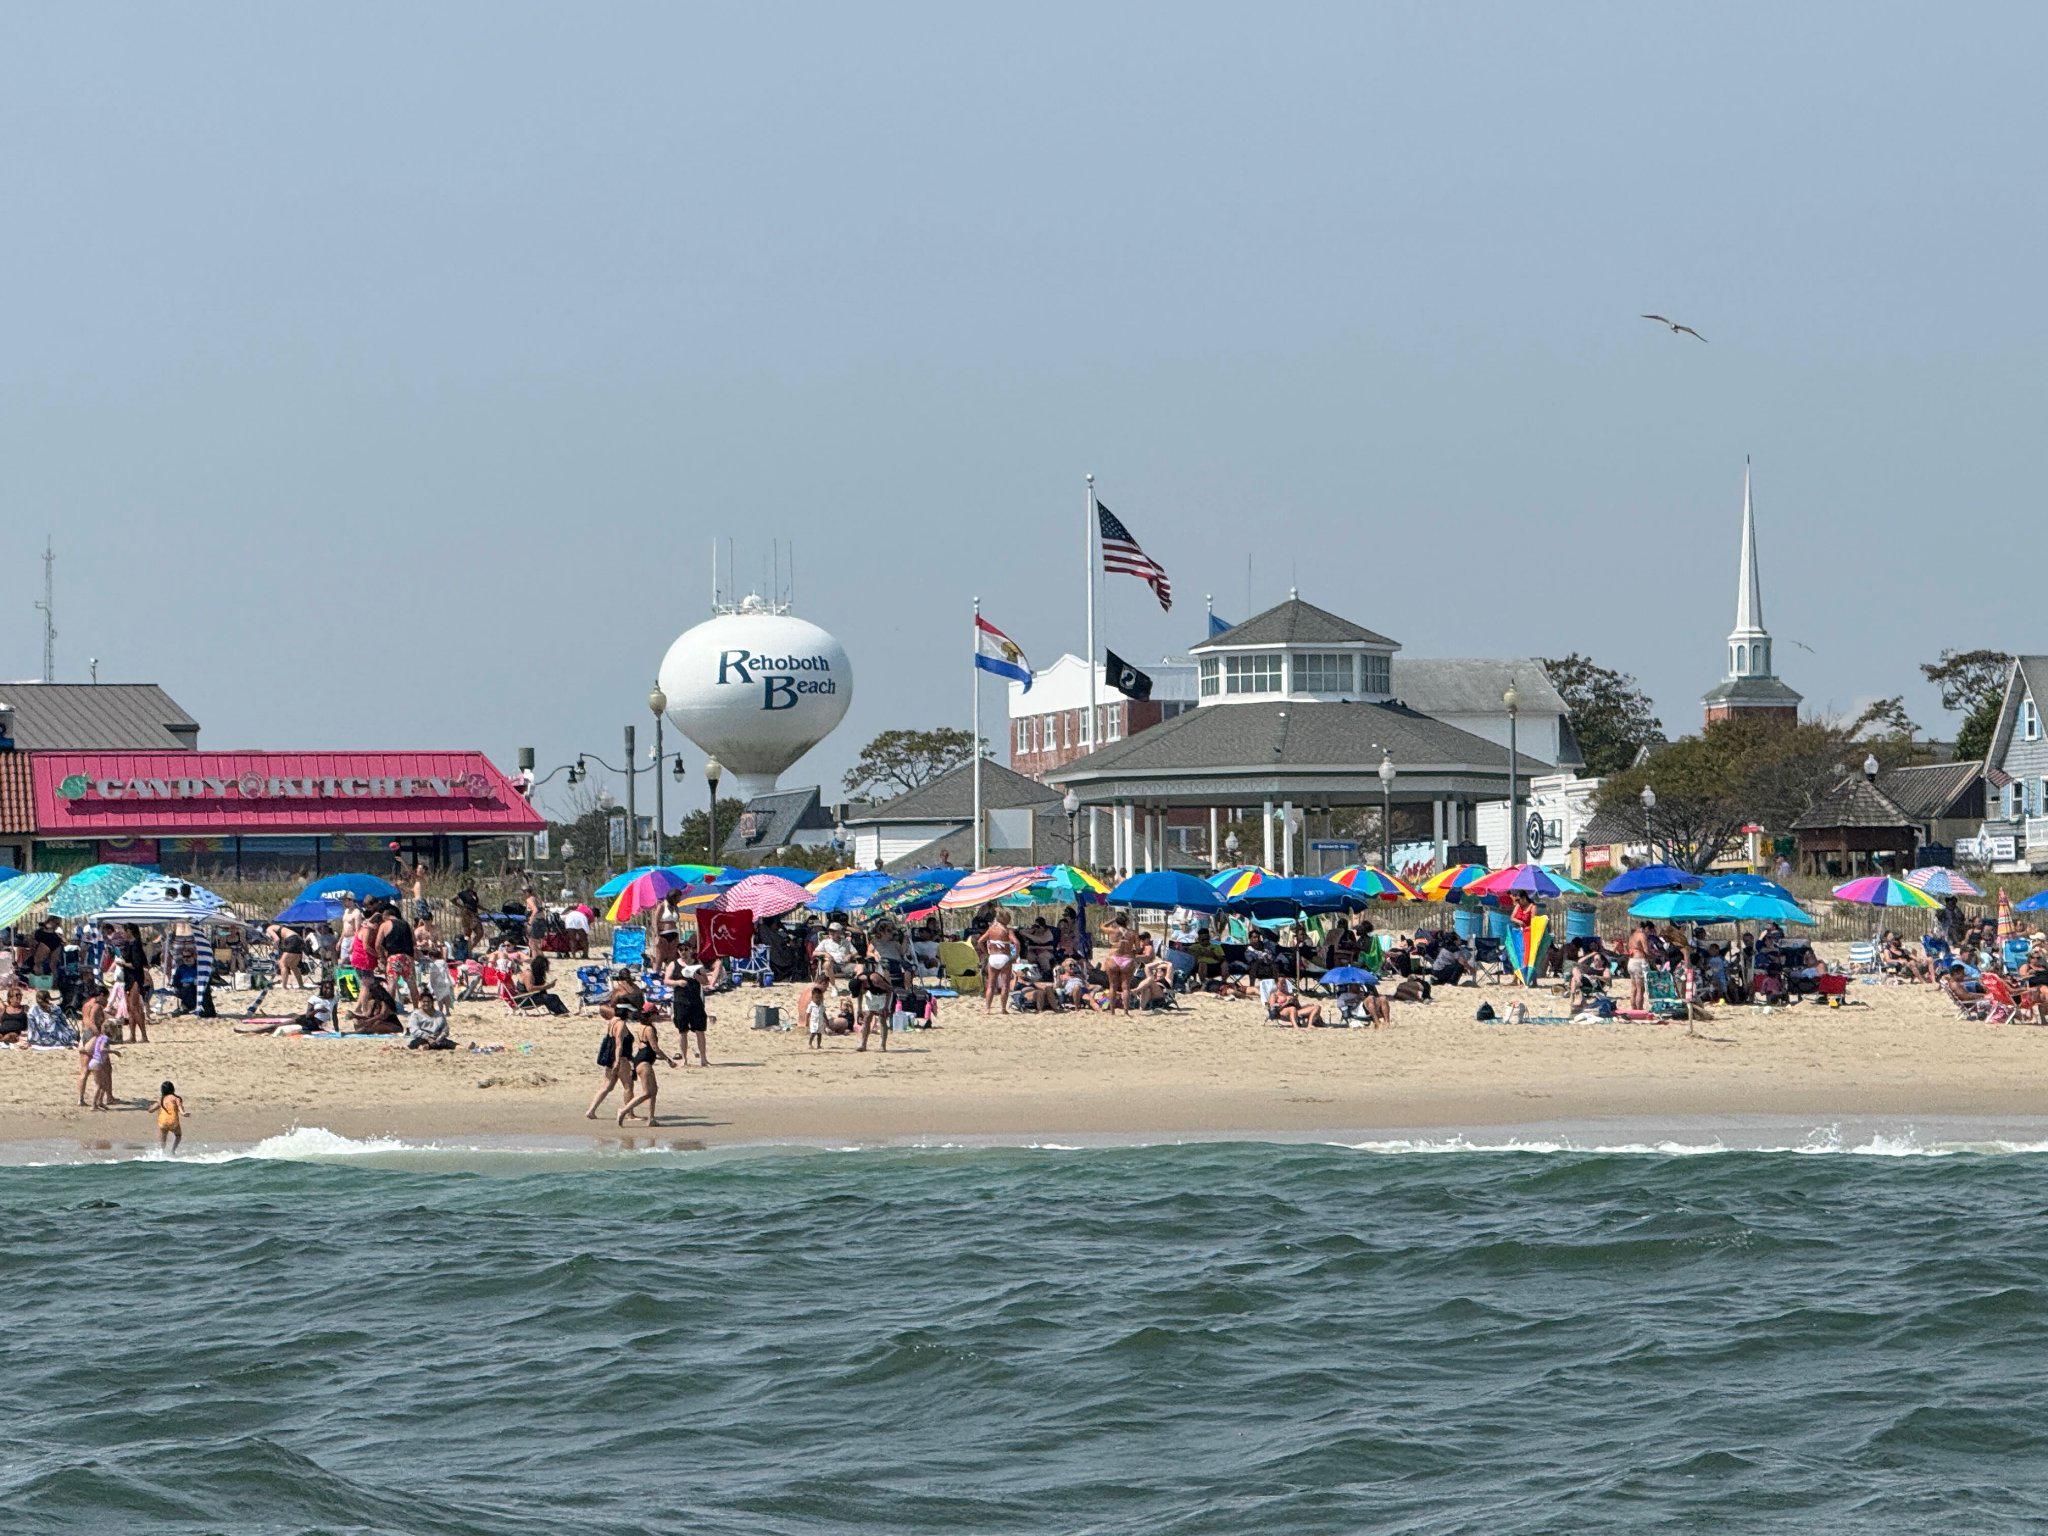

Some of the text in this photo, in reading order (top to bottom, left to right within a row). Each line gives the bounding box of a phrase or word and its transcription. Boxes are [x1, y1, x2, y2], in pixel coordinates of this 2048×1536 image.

[716, 650, 830, 684] Rehoboth
[761, 676, 836, 710] Beach
[97, 777, 451, 798] CANDY KITCHEN
